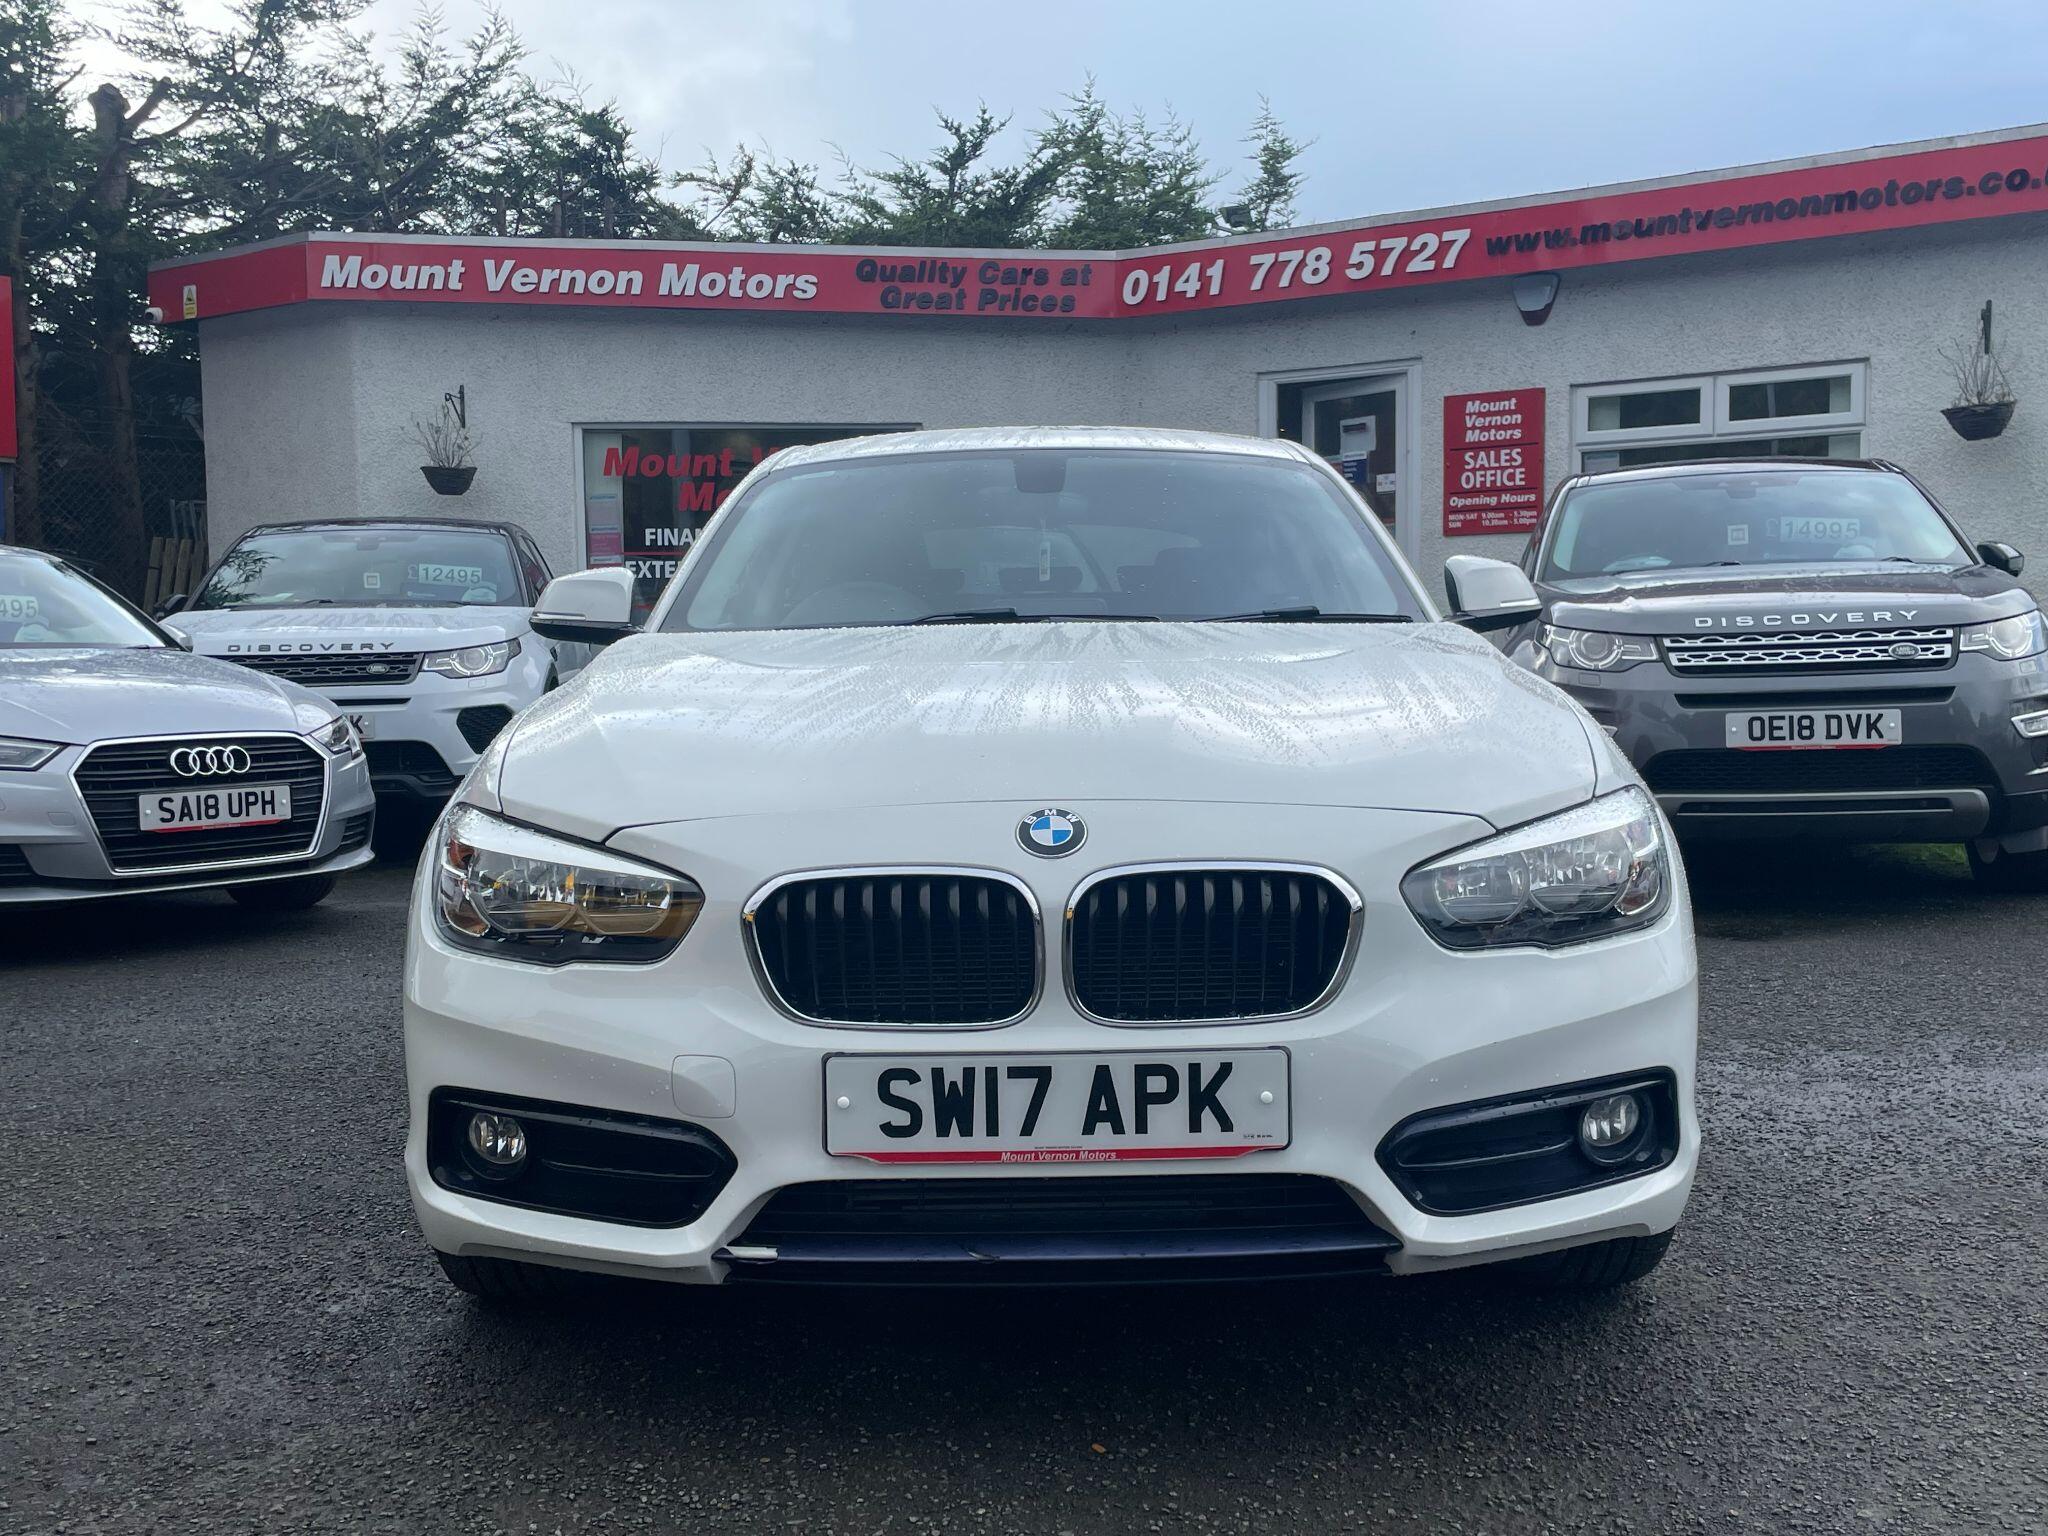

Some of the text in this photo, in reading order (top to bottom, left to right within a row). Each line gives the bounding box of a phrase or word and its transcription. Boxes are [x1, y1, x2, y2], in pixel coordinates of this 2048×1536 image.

[1486, 166, 2048, 257] www.mountvernonmotors.co.
[321, 255, 818, 299] Mount Vernon Motors
[855, 258, 1093, 288] Quality Cars at
[1122, 229, 1471, 305] 0141 778 5727
[880, 286, 1076, 313] Great Prices
[1465, 398, 1517, 413] Mount
[1465, 414, 1522, 428] Vernon
[1465, 429, 1522, 442] Motors
[603, 447, 735, 477] Mount
[1464, 448, 1522, 469] SALES
[1461, 468, 1526, 490] OFFICE
[1449, 493, 1536, 507] Opening Hours
[625, 561, 684, 578] EXTE
[1694, 610, 1918, 628] DISCOVERY
[228, 642, 394, 652] DISCOVERY
[1748, 713, 1884, 741] OE18 DVK
[158, 790, 276, 823] SA18 UPH
[1024, 809, 1079, 824] BMW
[877, 1062, 1234, 1138] SW17 APK
[1000, 1150, 1117, 1162] Mount Vernon Motors
